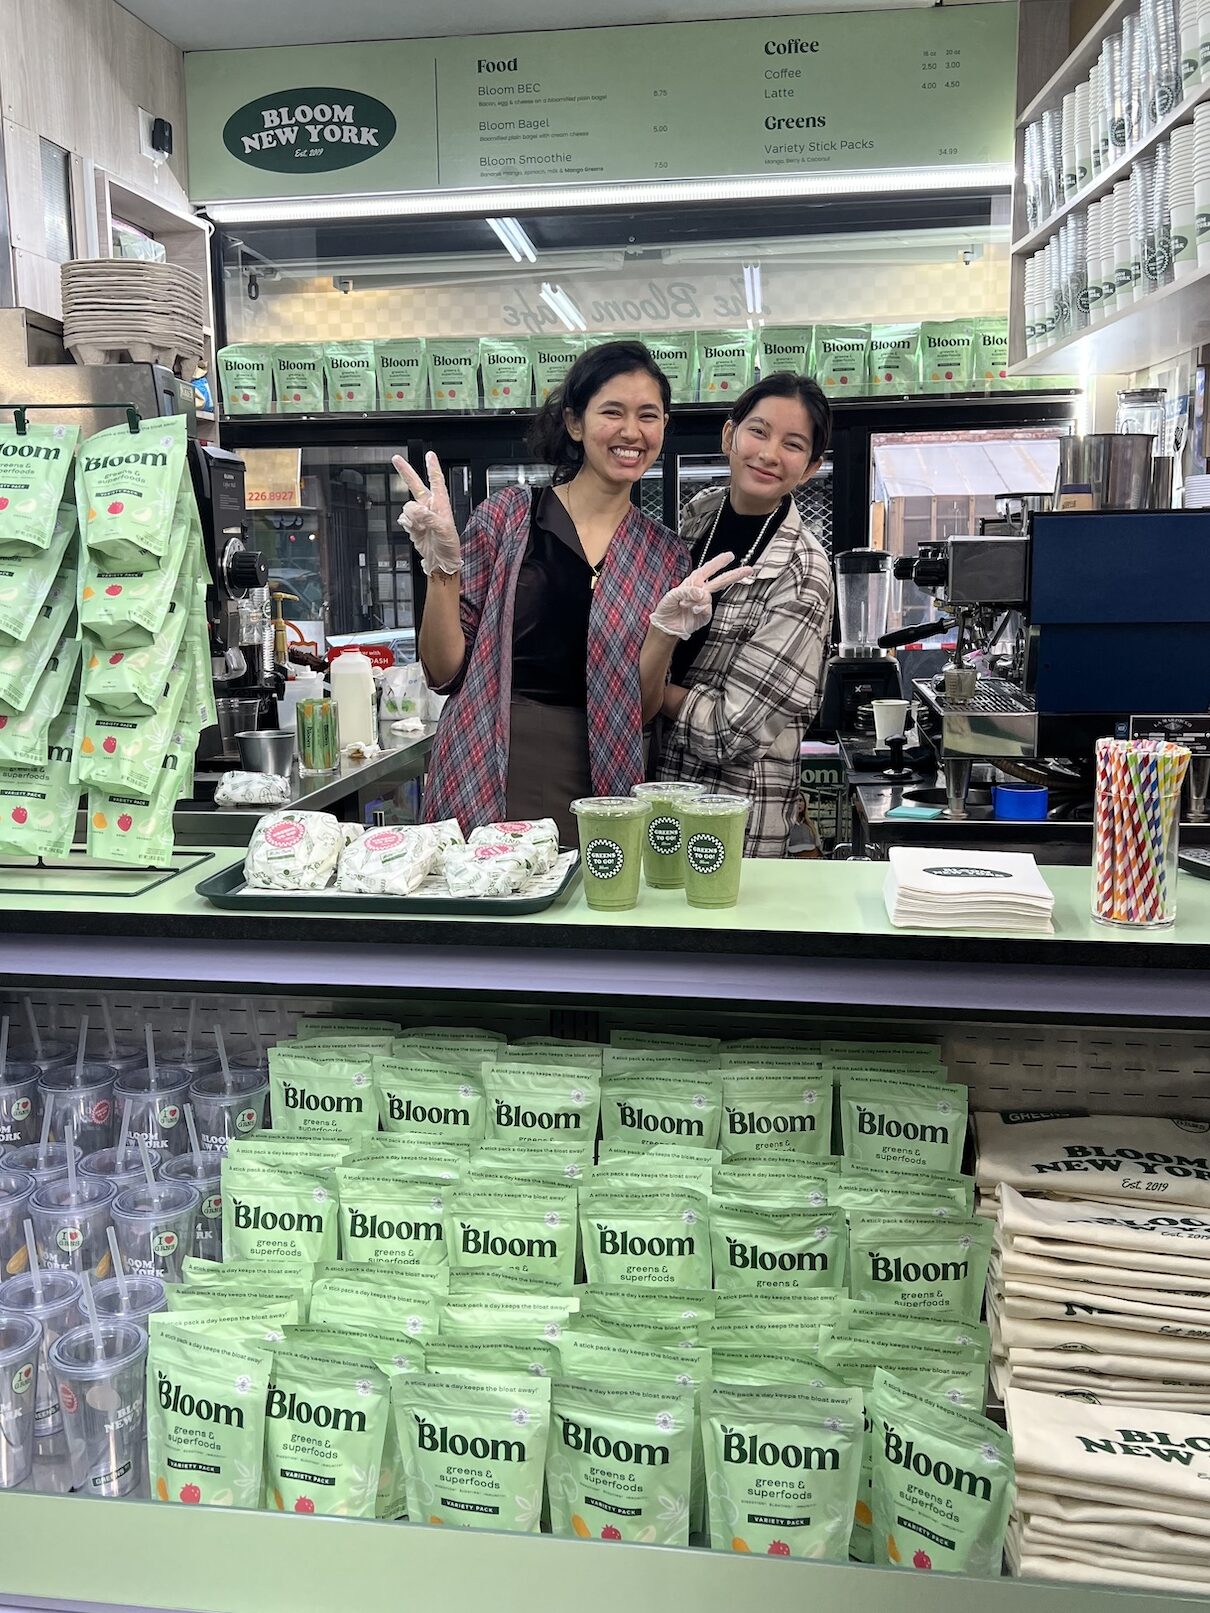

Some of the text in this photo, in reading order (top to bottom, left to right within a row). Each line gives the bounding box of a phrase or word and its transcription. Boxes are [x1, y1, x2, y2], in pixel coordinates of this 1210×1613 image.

[764, 39, 819, 55] Coffee
[477, 58, 518, 73] Food
[945, 61, 960, 69] 3.00
[764, 69, 802, 80] Coffee
[478, 83, 541, 96] Bloom BEC
[944, 80, 960, 88] 4.50
[764, 88, 794, 98] Latte
[261, 104, 355, 128] BLOOM
[764, 115, 826, 130] Greens
[479, 118, 550, 131] Bloom Bagel
[241, 124, 379, 154] NEW YORK
[764, 139, 874, 154] Variety Stick Packs
[480, 153, 572, 166] Bloom Smoothie
[764, 343, 805, 355] Bloom
[823, 341, 864, 353] Bloom
[870, 338, 910, 351] Bloom
[928, 336, 970, 348] Bloom
[488, 354, 526, 365] Bloom
[539, 352, 577, 364] Bloom
[704, 346, 745, 358] Bloom
[225, 359, 264, 371] Bloom
[279, 360, 315, 371] Bloom
[331, 358, 369, 369] Bloom
[381, 356, 419, 368] Bloom
[433, 354, 472, 366] Bloom
[84, 452, 167, 472] Bloom
[3, 771, 50, 780] superfoods
[591, 852, 616, 860] GREENS
[284, 1087, 363, 1113] Bloom
[389, 1098, 470, 1126] Bloom
[496, 1104, 580, 1129] Bloom
[620, 1104, 704, 1137] Bloom
[728, 1112, 816, 1136] Bloom
[858, 1112, 949, 1145] Bloom
[1063, 1146, 1209, 1169] BLOOM
[1032, 1160, 1123, 1174] NEW
[1122, 1178, 1169, 1192] Est. 2019
[234, 1203, 323, 1233] Bloom
[349, 1212, 443, 1241] Bloom
[460, 1228, 557, 1258] Bloom
[599, 1229, 695, 1257] Bloom
[728, 1243, 828, 1271] Bloom
[869, 1255, 968, 1284] Bloom
[159, 1378, 244, 1429] Bloom
[266, 1388, 366, 1432] Bloom
[174, 1425, 206, 1438] greens
[168, 1434, 221, 1451] superfoods
[291, 1433, 331, 1448] greens &
[418, 1422, 526, 1462] Bloom
[562, 1421, 669, 1465] Bloom
[282, 1442, 338, 1460] superfoods
[724, 1433, 840, 1470] Bloom
[1075, 1436, 1194, 1465] NEW
[446, 1466, 493, 1478] greens &
[590, 1466, 635, 1481] greens &
[884, 1431, 992, 1502] Bloom
[314, 1476, 329, 1485] PACK
[440, 1474, 500, 1490] superfoods
[584, 1472, 643, 1492] superfoods
[755, 1478, 805, 1490] greens &
[748, 1487, 812, 1501] superfoods
[907, 1483, 953, 1509] greens &
[476, 1505, 493, 1513] PACK
[618, 1507, 636, 1515] PACK
[900, 1490, 960, 1523] superfoods
